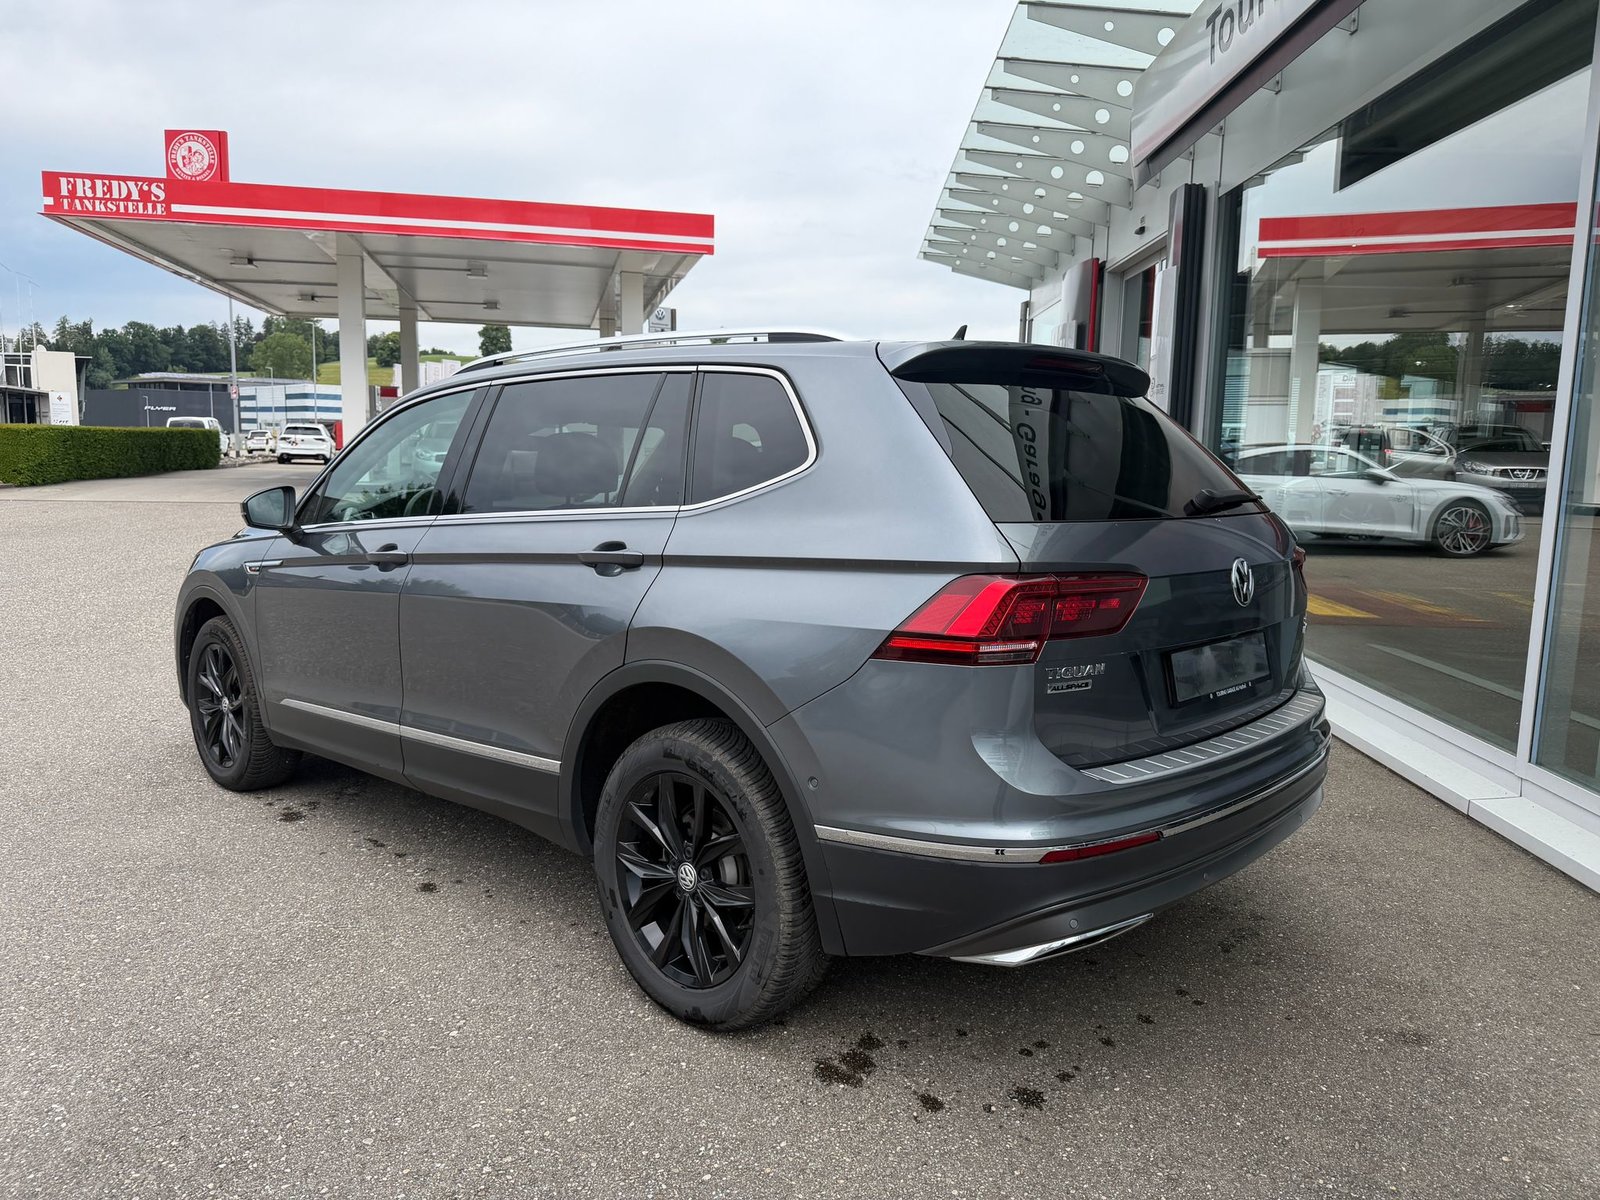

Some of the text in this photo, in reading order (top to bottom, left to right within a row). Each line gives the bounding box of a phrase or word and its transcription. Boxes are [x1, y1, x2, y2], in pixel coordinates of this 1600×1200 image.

[60, 198, 167, 216] TANKSTELLE
[1045, 662, 1106, 680] TIGUAN
[1050, 681, 1090, 692] ALLSPACE
